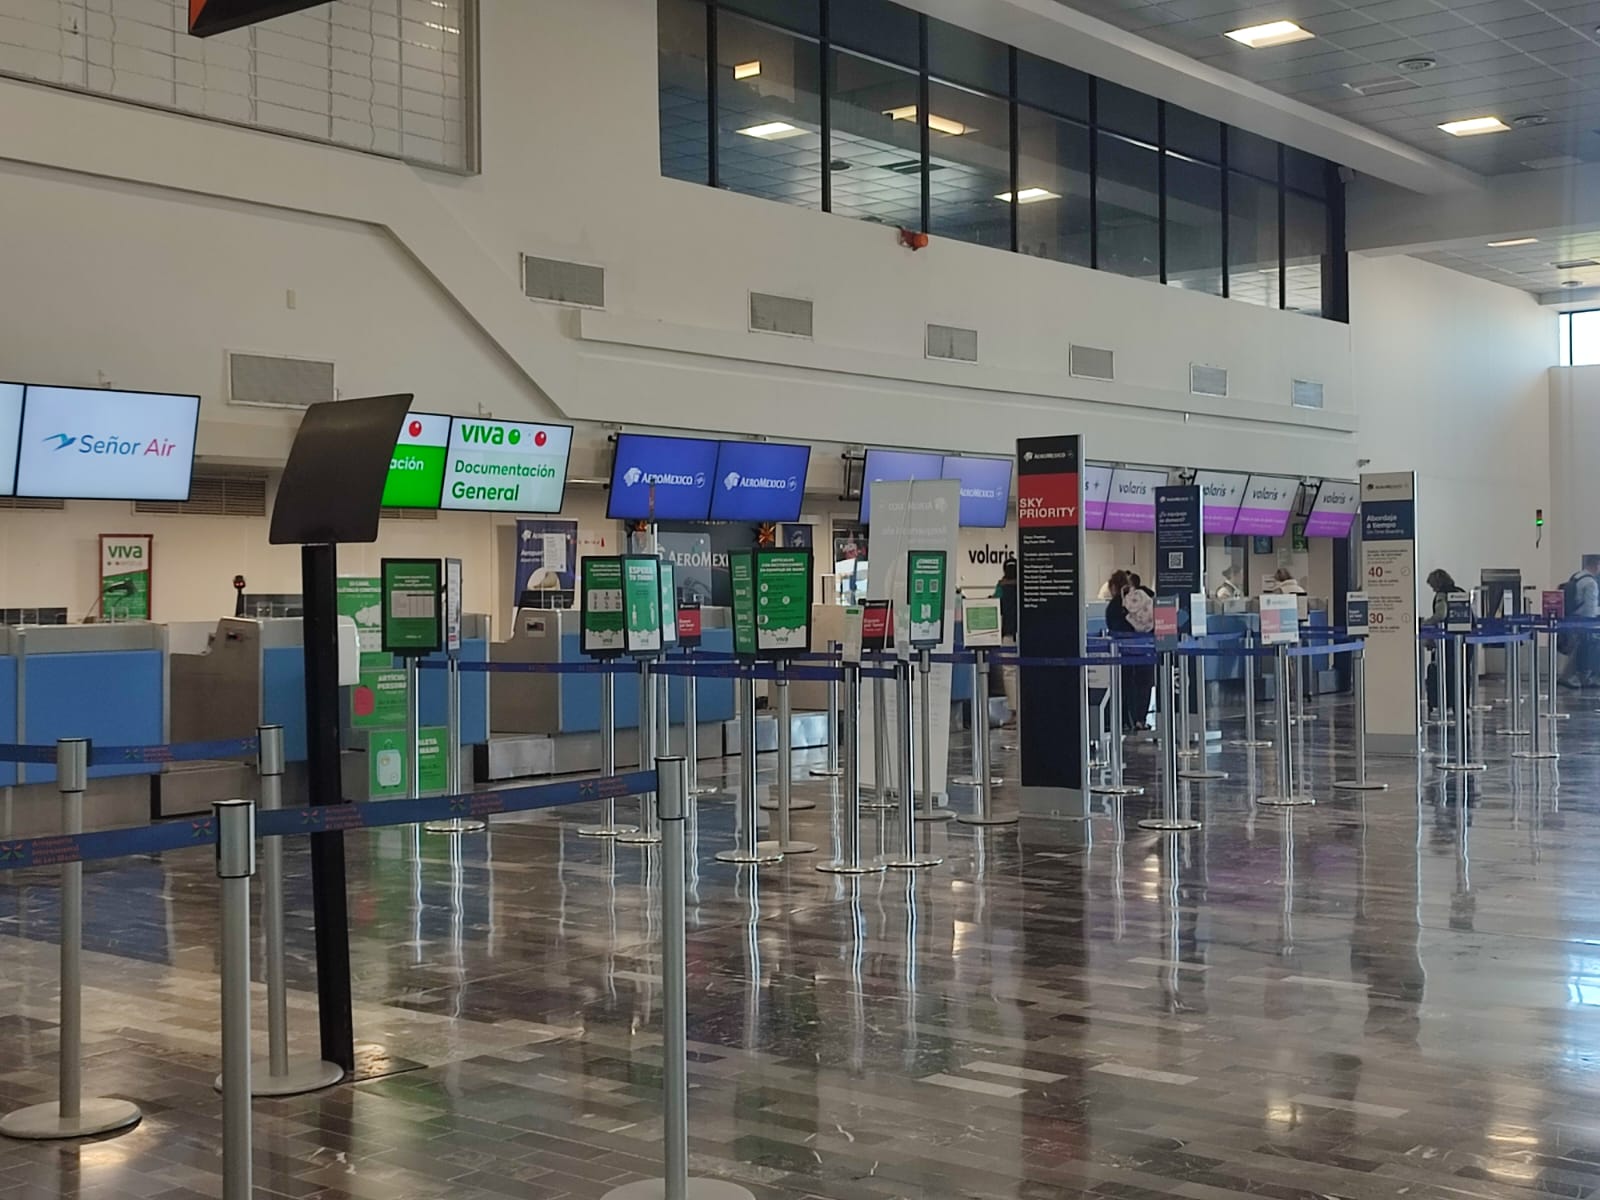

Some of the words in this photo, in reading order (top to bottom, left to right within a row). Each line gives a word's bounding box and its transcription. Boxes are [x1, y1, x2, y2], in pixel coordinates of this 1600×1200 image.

[78, 434, 141, 456] Señor
[143, 437, 176, 457] Air
[389, 456, 425, 470] ación
[454, 459, 556, 478] Documentación
[451, 481, 520, 501] General
[1119, 481, 1146, 495] volaris
[1252, 486, 1278, 501] volaris
[1019, 497, 1043, 508] SKY
[1323, 492, 1346, 504] volaris
[1019, 507, 1075, 519] PRIORITY
[668, 550, 729, 567] AEROMEXI
[968, 543, 1015, 564] volaris
[1368, 566, 1383, 577] 40
[1369, 612, 1384, 624] 30
